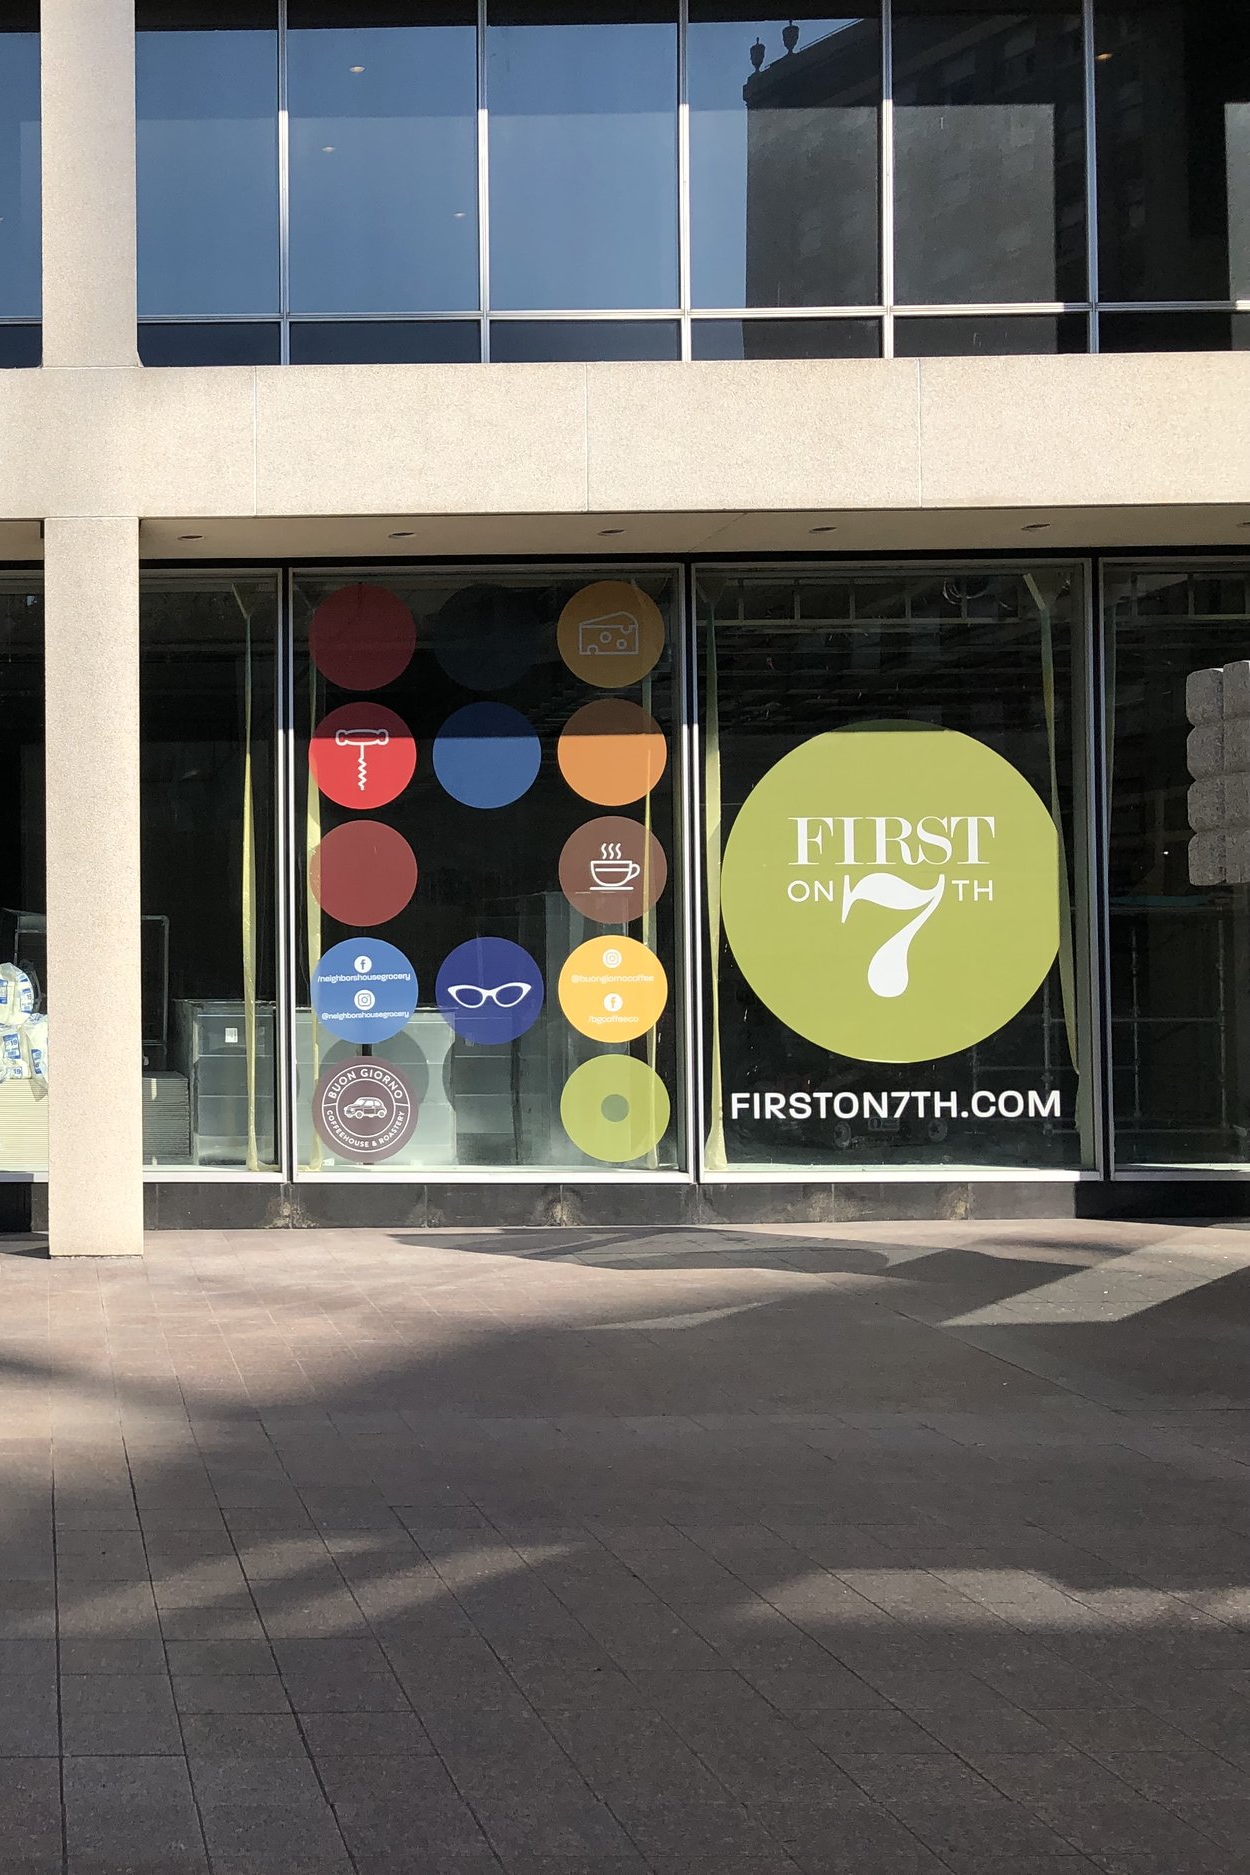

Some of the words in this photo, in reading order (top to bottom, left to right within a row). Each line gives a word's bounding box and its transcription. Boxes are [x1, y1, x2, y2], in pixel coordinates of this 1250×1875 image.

[787, 815, 996, 866] FIRST
[787, 878, 835, 903] ON
[327, 1070, 357, 1099] BUON
[360, 1068, 403, 1099] GIORNO
[730, 1089, 1062, 1119] FIRSTON7TH.COM
[326, 1109, 370, 1148] COFFEEHOUSE
[378, 1110, 406, 1145] ROASTERY
